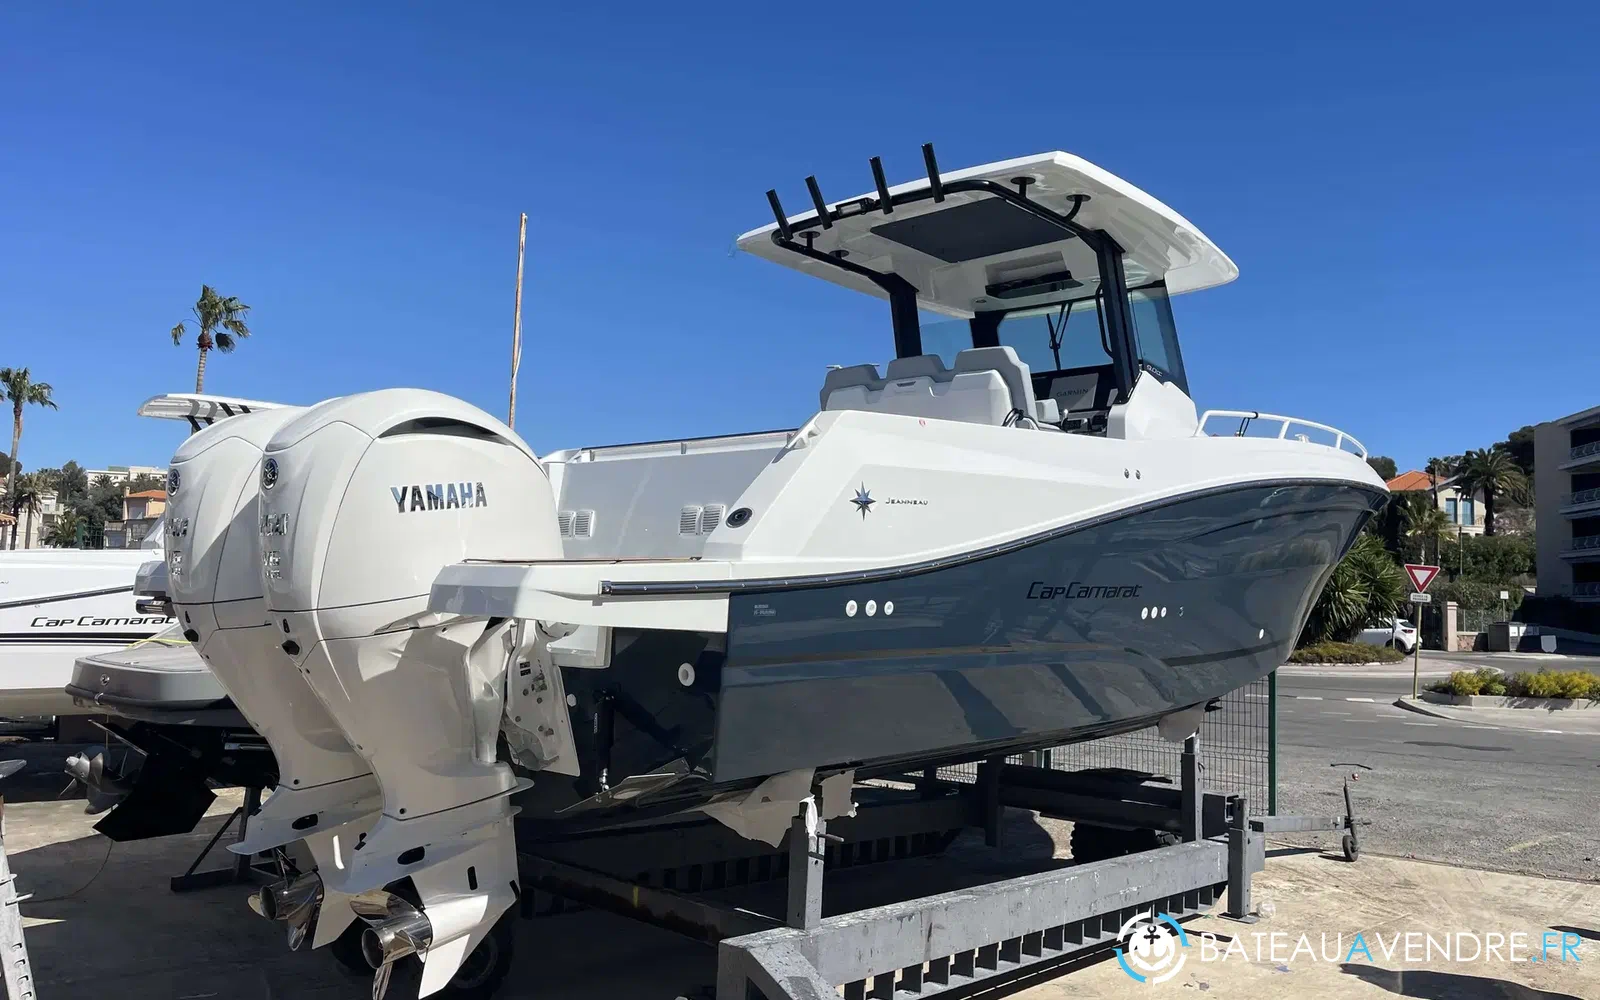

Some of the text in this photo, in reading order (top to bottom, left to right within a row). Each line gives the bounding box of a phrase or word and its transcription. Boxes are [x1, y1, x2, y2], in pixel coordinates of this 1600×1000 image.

[1056, 387, 1089, 398] GARMIN
[390, 482, 488, 514] YAMAHA
[30, 616, 75, 628] Cap
